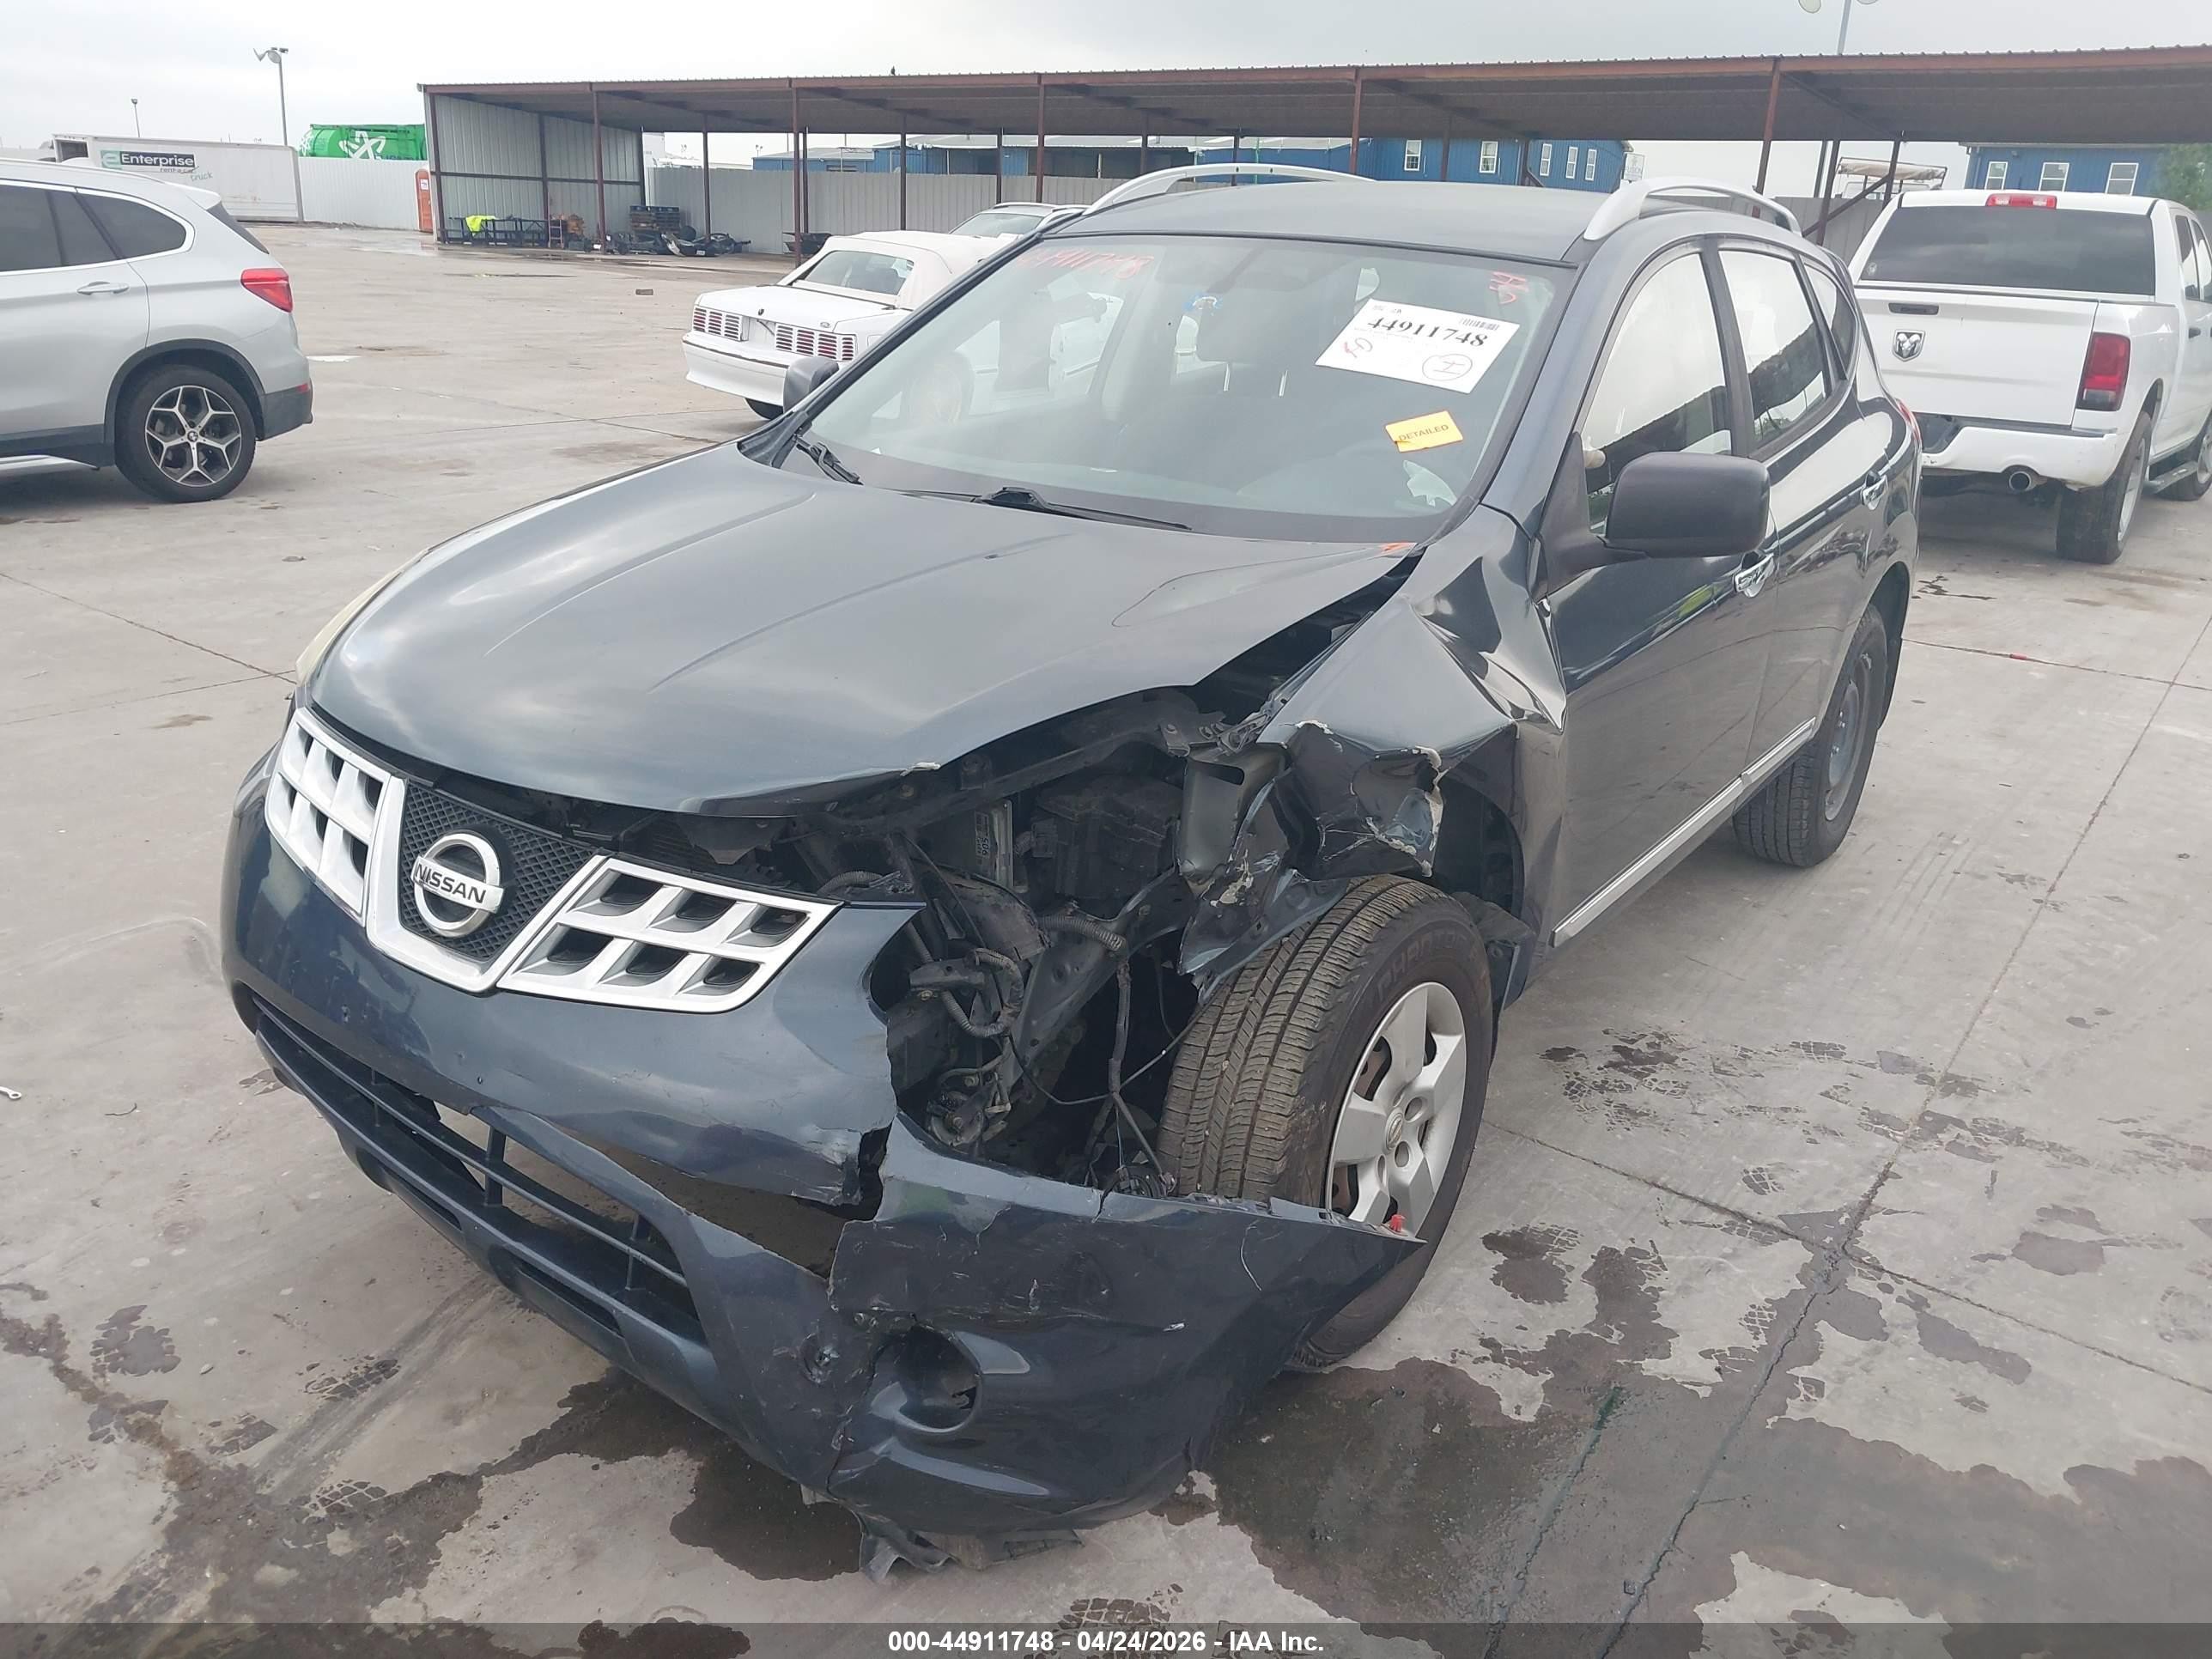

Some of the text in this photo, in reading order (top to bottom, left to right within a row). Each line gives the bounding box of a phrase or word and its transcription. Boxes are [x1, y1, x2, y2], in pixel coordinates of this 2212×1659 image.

[121, 153, 194, 167] Enterprise
[1367, 317, 1488, 346] 44911748
[1398, 424, 1449, 441] DETAILED
[415, 863, 487, 904] NISSAN
